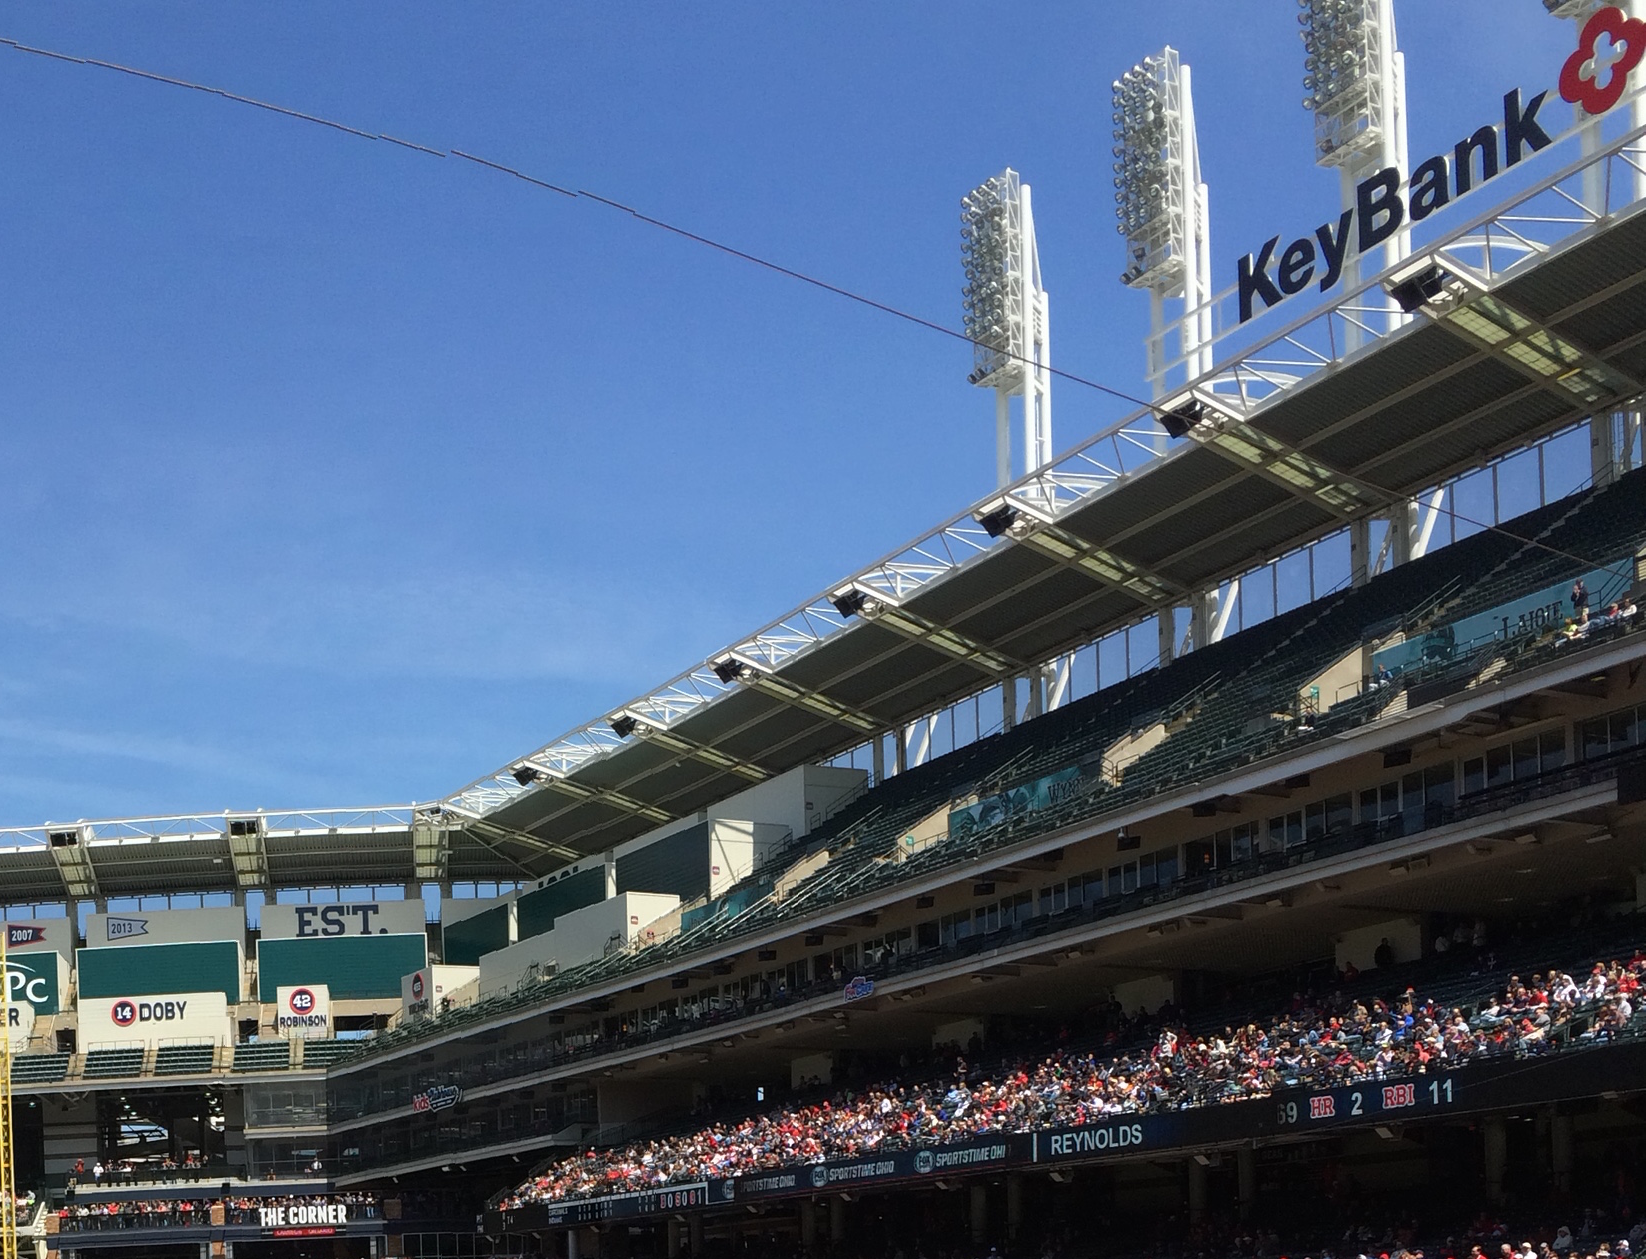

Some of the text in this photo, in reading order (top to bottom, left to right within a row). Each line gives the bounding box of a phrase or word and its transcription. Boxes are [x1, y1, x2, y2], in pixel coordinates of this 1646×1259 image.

[1238, 88, 1554, 325] KeyBank
[11, 930, 33, 942] 2007
[111, 923, 133, 934] 2013
[292, 994, 312, 1007] 42
[116, 1001, 187, 1022] 14 DOBY
[279, 1015, 327, 1028] ROBINSON
[1050, 1078, 1453, 1156] REYNOLDS HR RBI 11
[258, 1204, 348, 1227] THE CORNER
